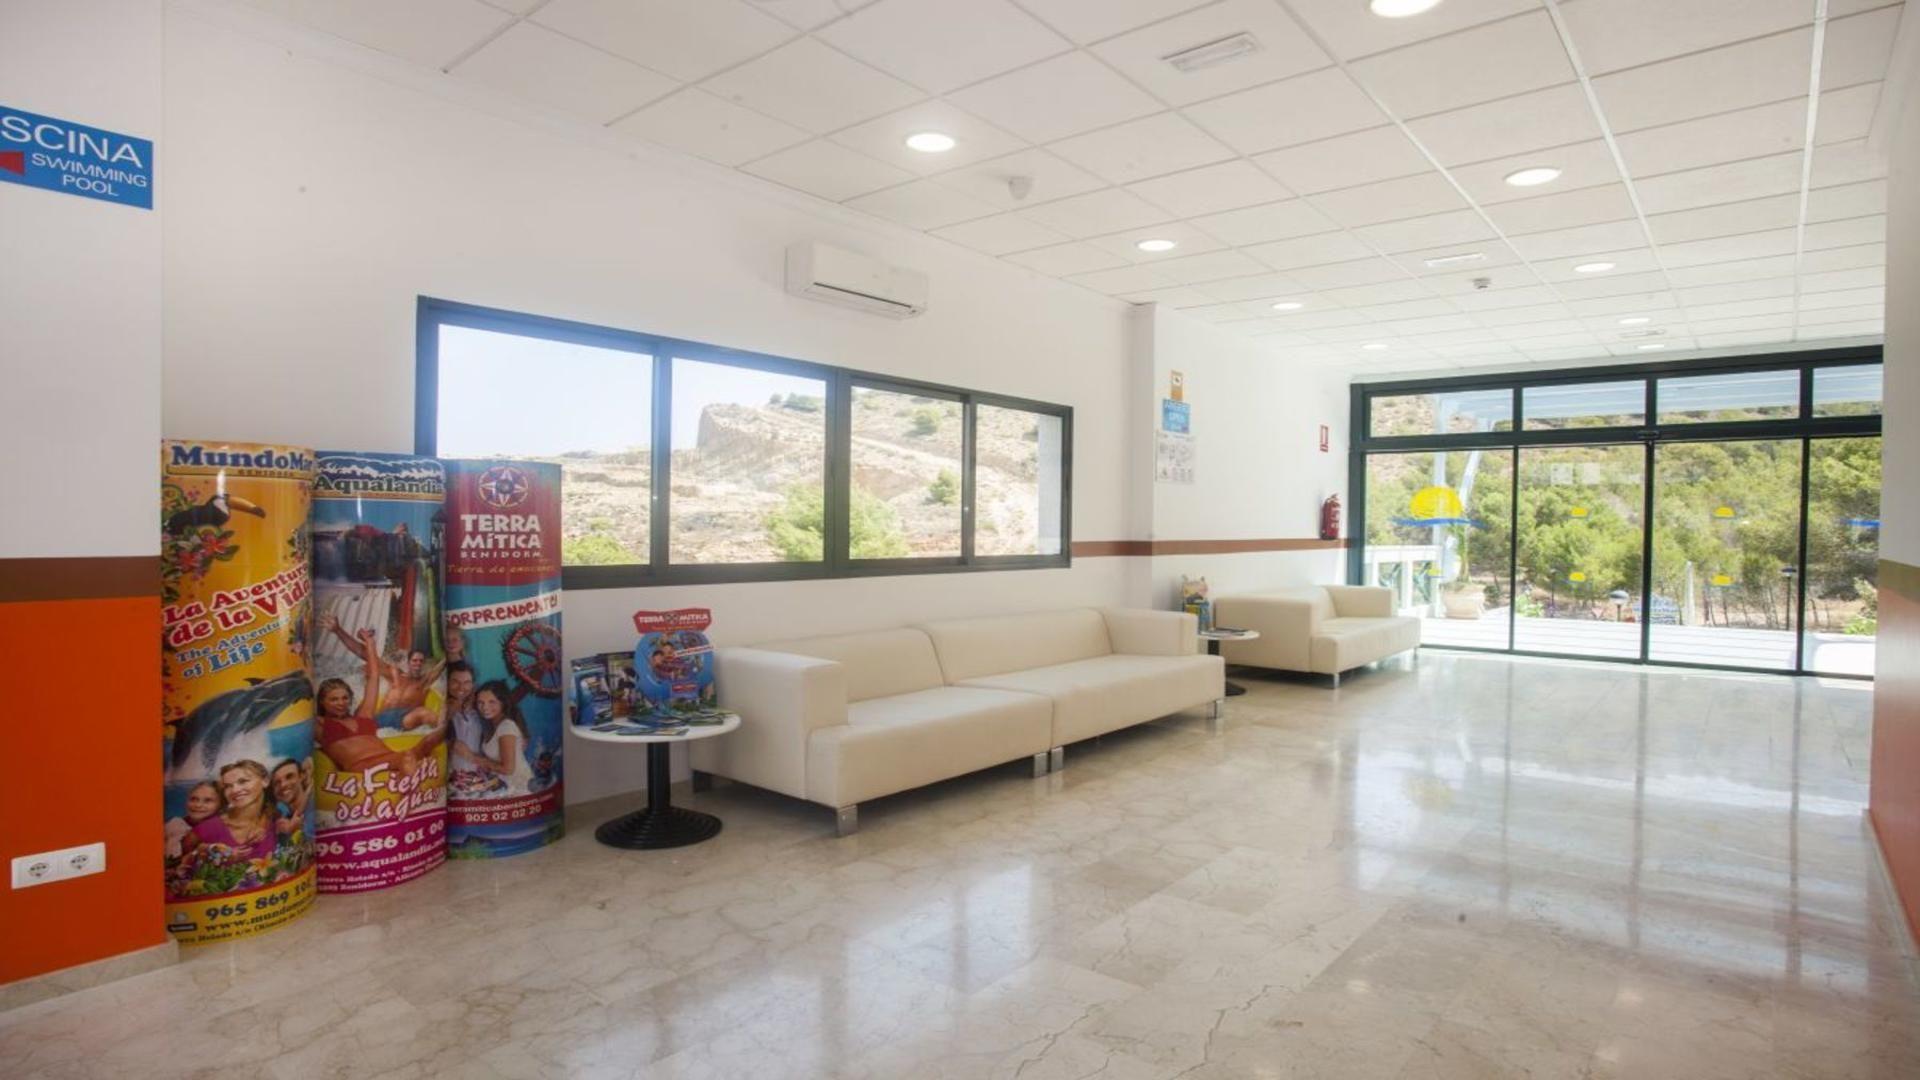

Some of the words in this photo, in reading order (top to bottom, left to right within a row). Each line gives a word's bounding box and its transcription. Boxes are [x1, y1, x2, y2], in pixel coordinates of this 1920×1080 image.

[0, 116, 143, 169] SCINA
[32, 153, 147, 187] SWIMMING
[63, 174, 119, 196] POOL
[313, 475, 445, 494] Aqualandia
[460, 514, 542, 533] TERRA
[460, 551, 542, 559] BENIDORM
[164, 602, 205, 625] La
[171, 620, 211, 645] de
[216, 608, 253, 629] la
[176, 647, 211, 663] The
[183, 664, 203, 678] of
[208, 642, 265, 672] Life
[325, 772, 358, 798] La
[363, 757, 439, 793] Fiesta
[337, 796, 371, 821] del
[465, 812, 489, 822] 902
[492, 811, 508, 821] 02
[316, 841, 345, 857] 96
[352, 835, 399, 856] 586
[404, 828, 425, 845] 01
[429, 819, 445, 836] 00
[205, 902, 248, 921] 965
[255, 890, 289, 910] 869
